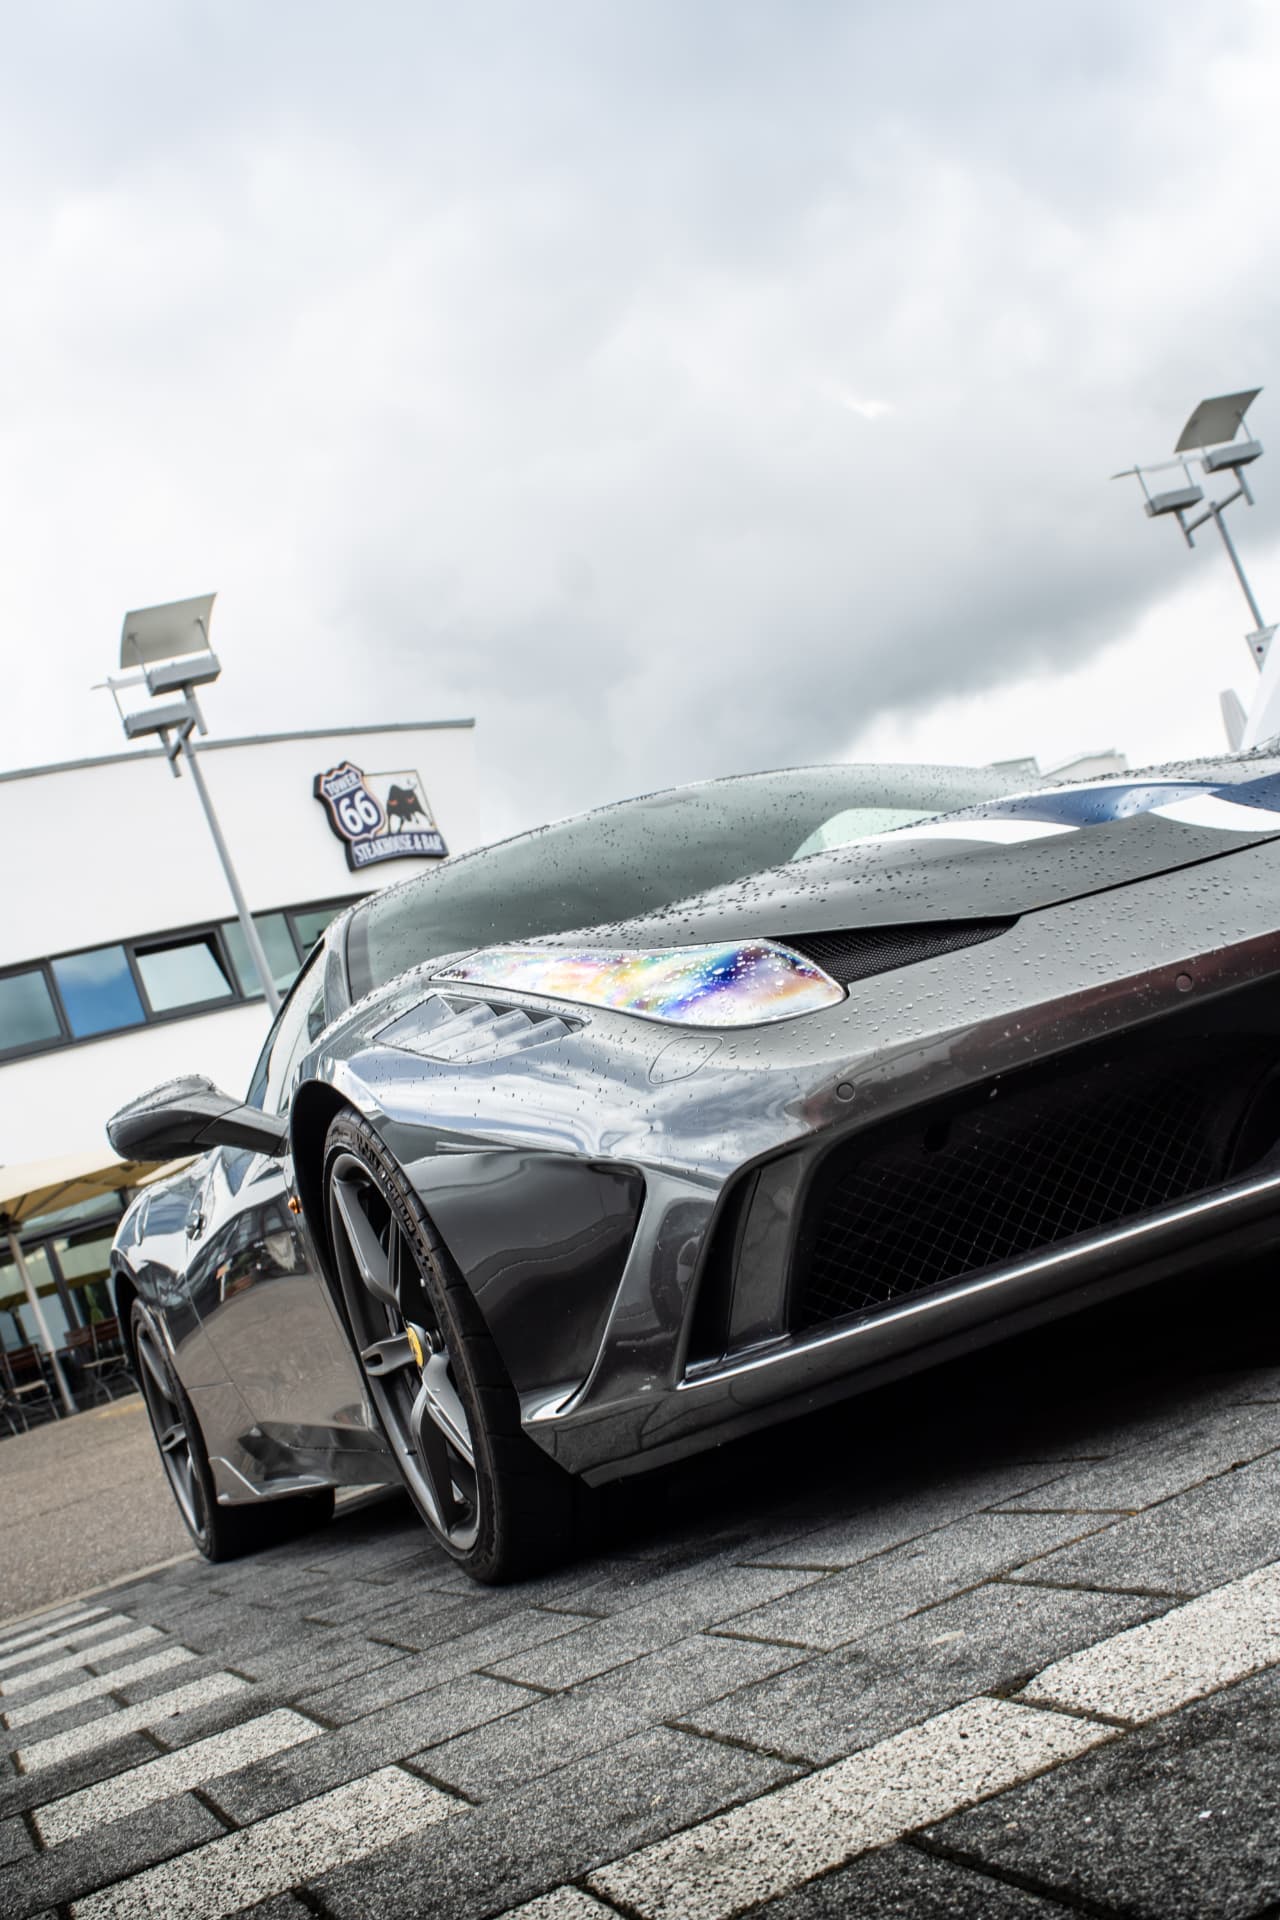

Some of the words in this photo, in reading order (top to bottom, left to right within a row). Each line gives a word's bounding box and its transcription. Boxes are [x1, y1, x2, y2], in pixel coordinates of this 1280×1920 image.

[326, 773, 359, 796] TOWER
[339, 790, 379, 834] 66
[354, 835, 412, 863] STEAKHOUSE
[413, 834, 421, 850] &
[421, 834, 443, 851] BAR
[378, 1164, 416, 1233] MICHELIN
